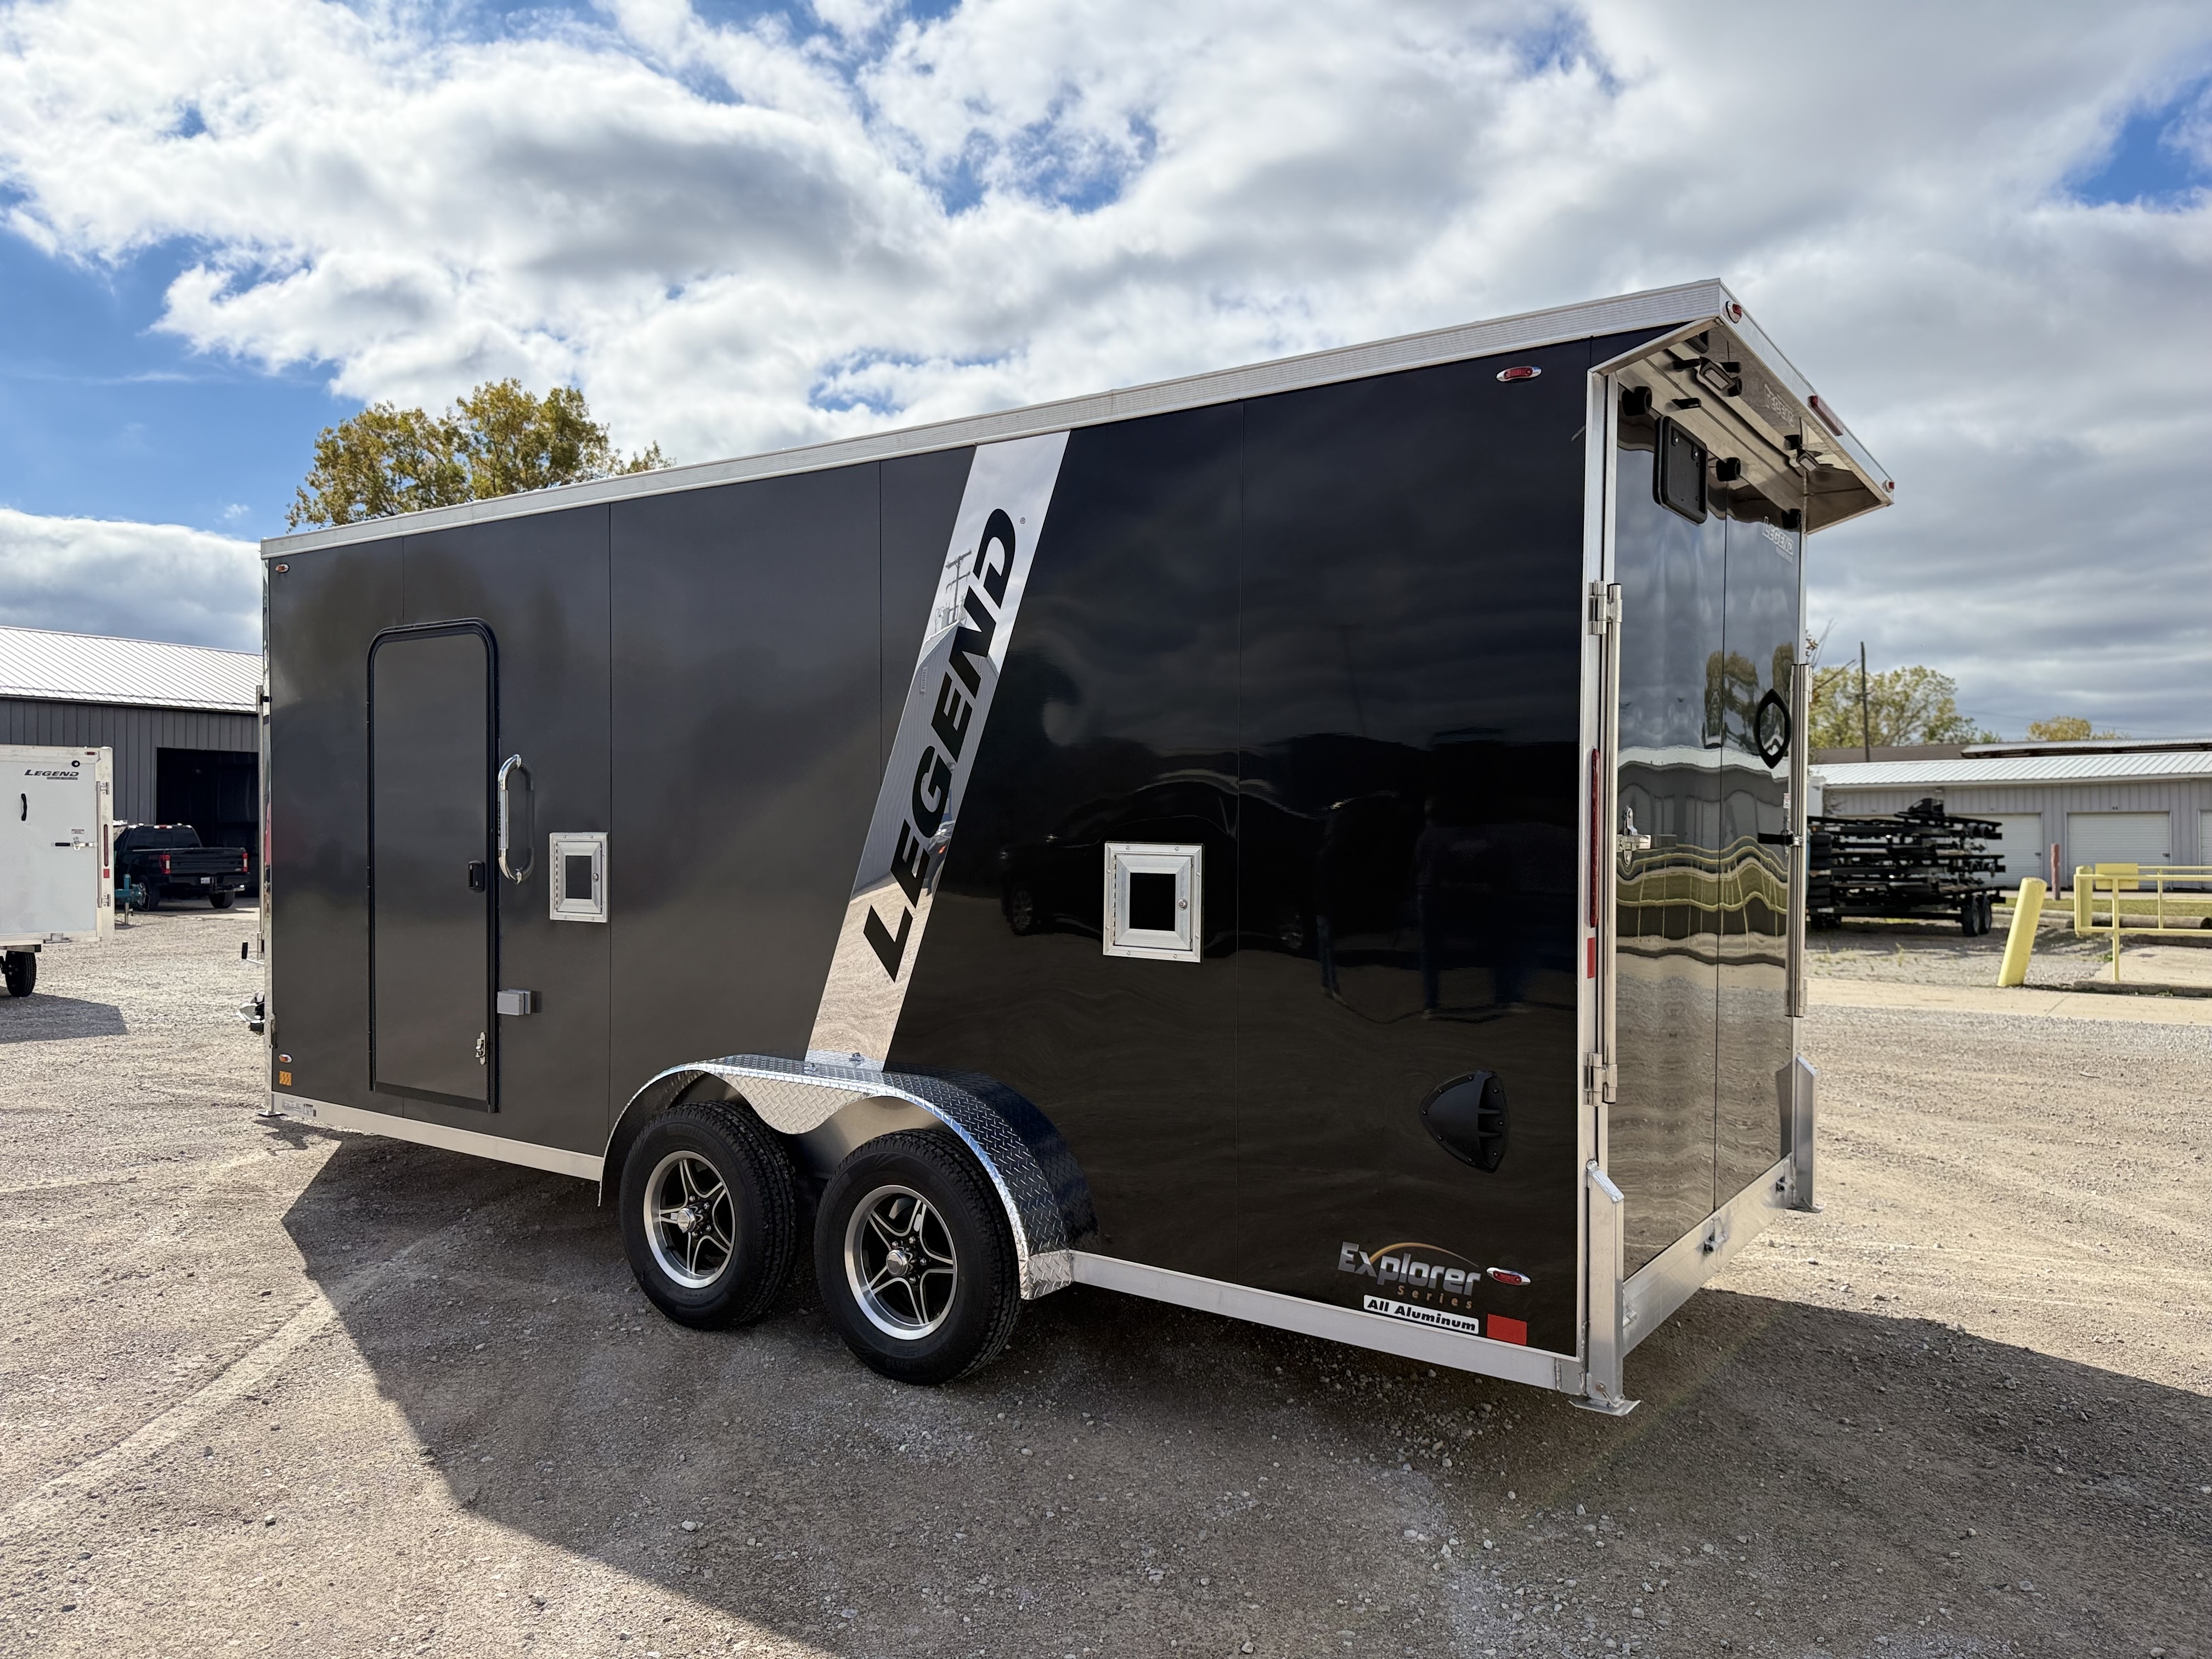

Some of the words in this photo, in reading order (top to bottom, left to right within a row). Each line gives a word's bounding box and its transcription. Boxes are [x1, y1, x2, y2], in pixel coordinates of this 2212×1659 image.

[1762, 516, 1794, 555] LEGEND
[864, 509, 1015, 981] LEGEND
[1338, 1241, 1481, 1296] Explorer
[1367, 1299, 1389, 1312] All
[1394, 1306, 1476, 1331] Aluminum
[1397, 1285, 1472, 1309] Series
